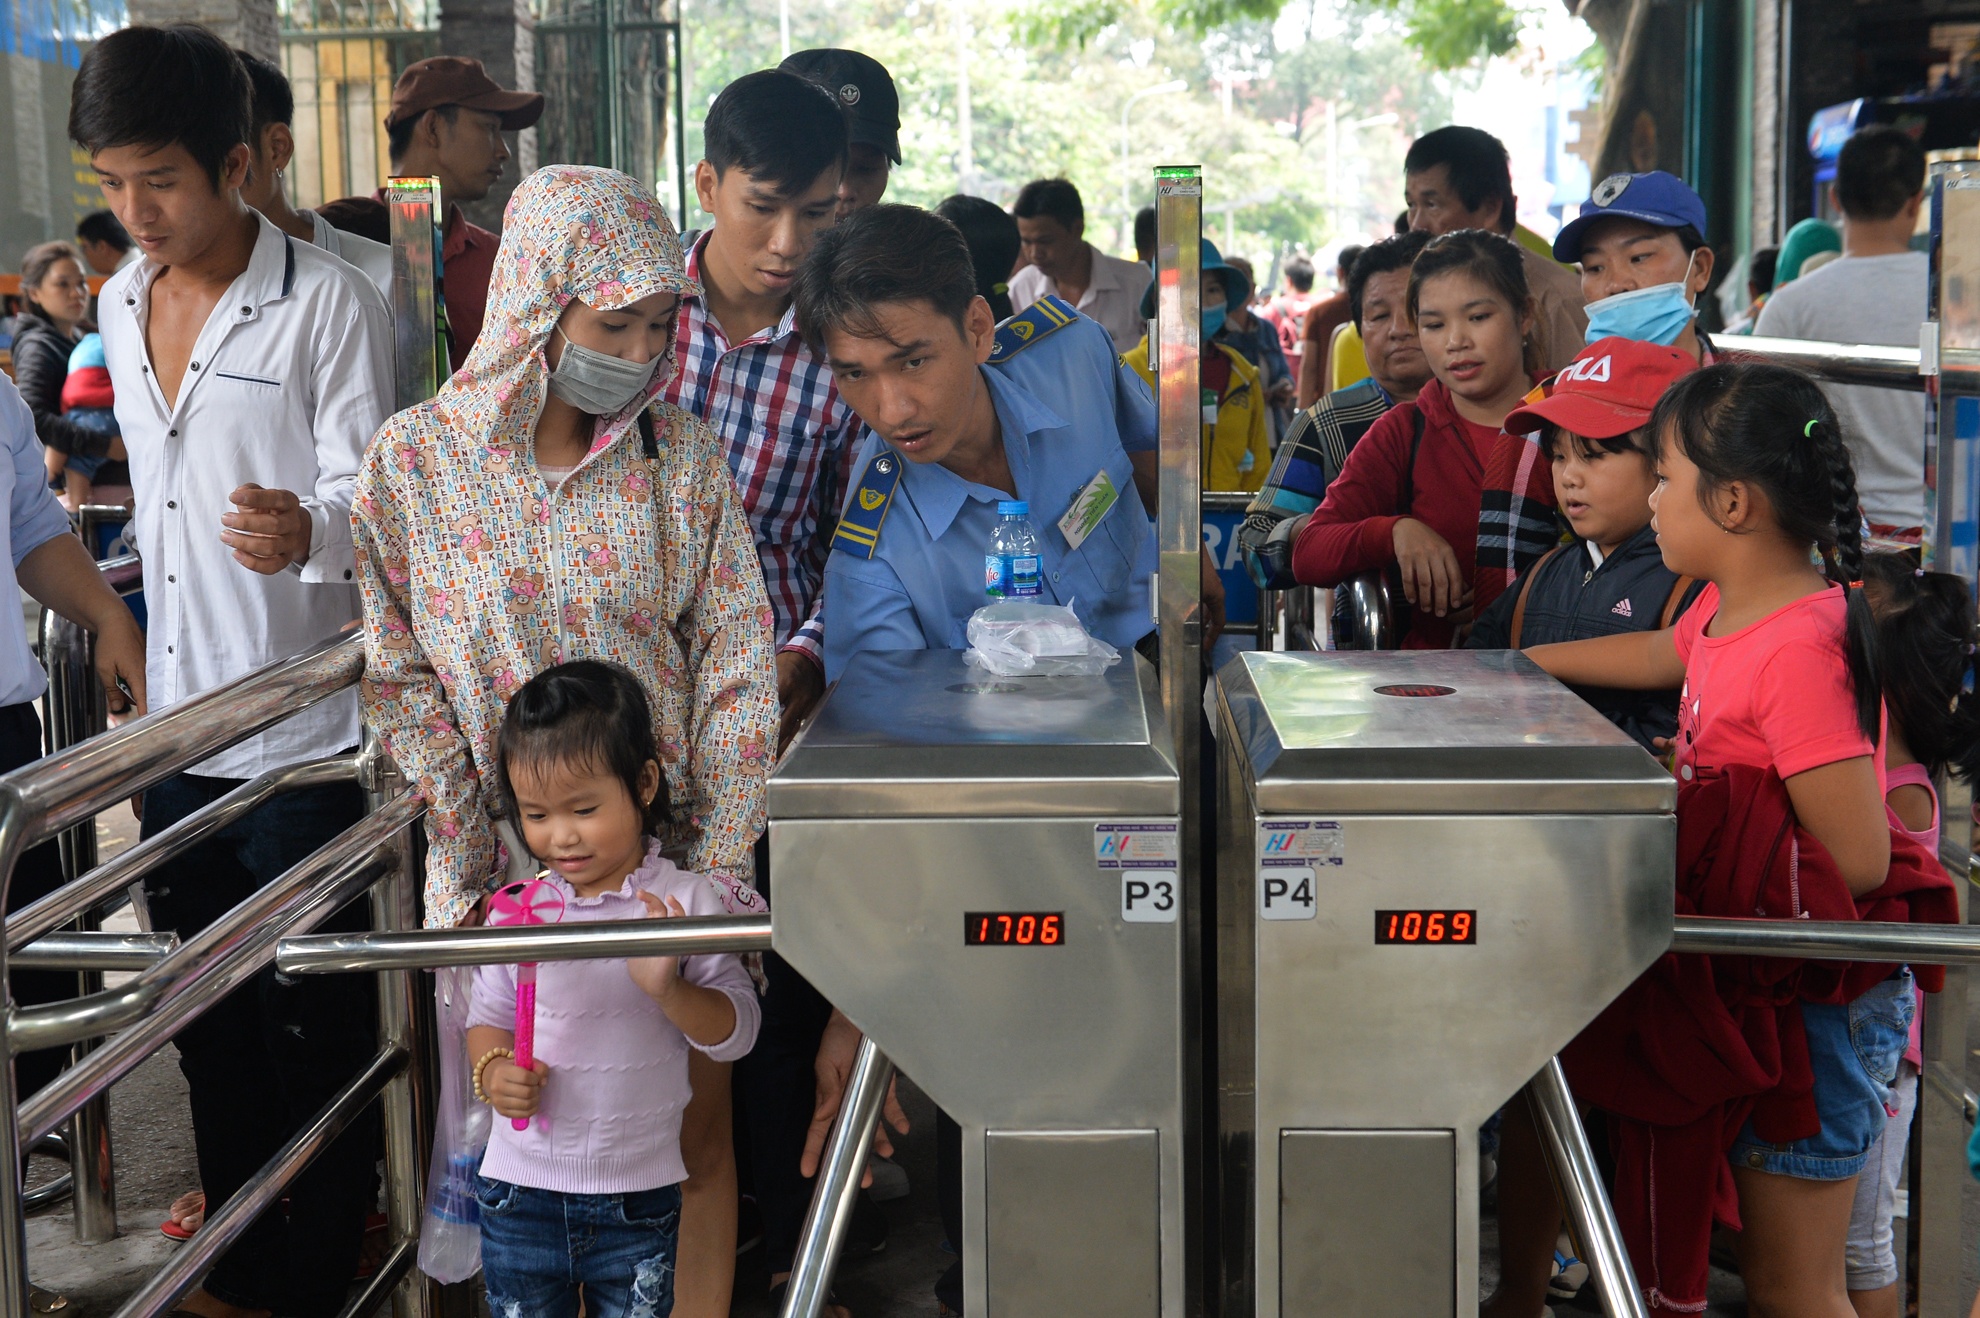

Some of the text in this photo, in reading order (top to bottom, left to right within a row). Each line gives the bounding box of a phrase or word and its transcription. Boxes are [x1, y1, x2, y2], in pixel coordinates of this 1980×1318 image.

[1126, 881, 1175, 911] P3
[1264, 877, 1314, 908] P4
[979, 915, 1060, 944] 1706
[1388, 912, 1471, 941] 1069
